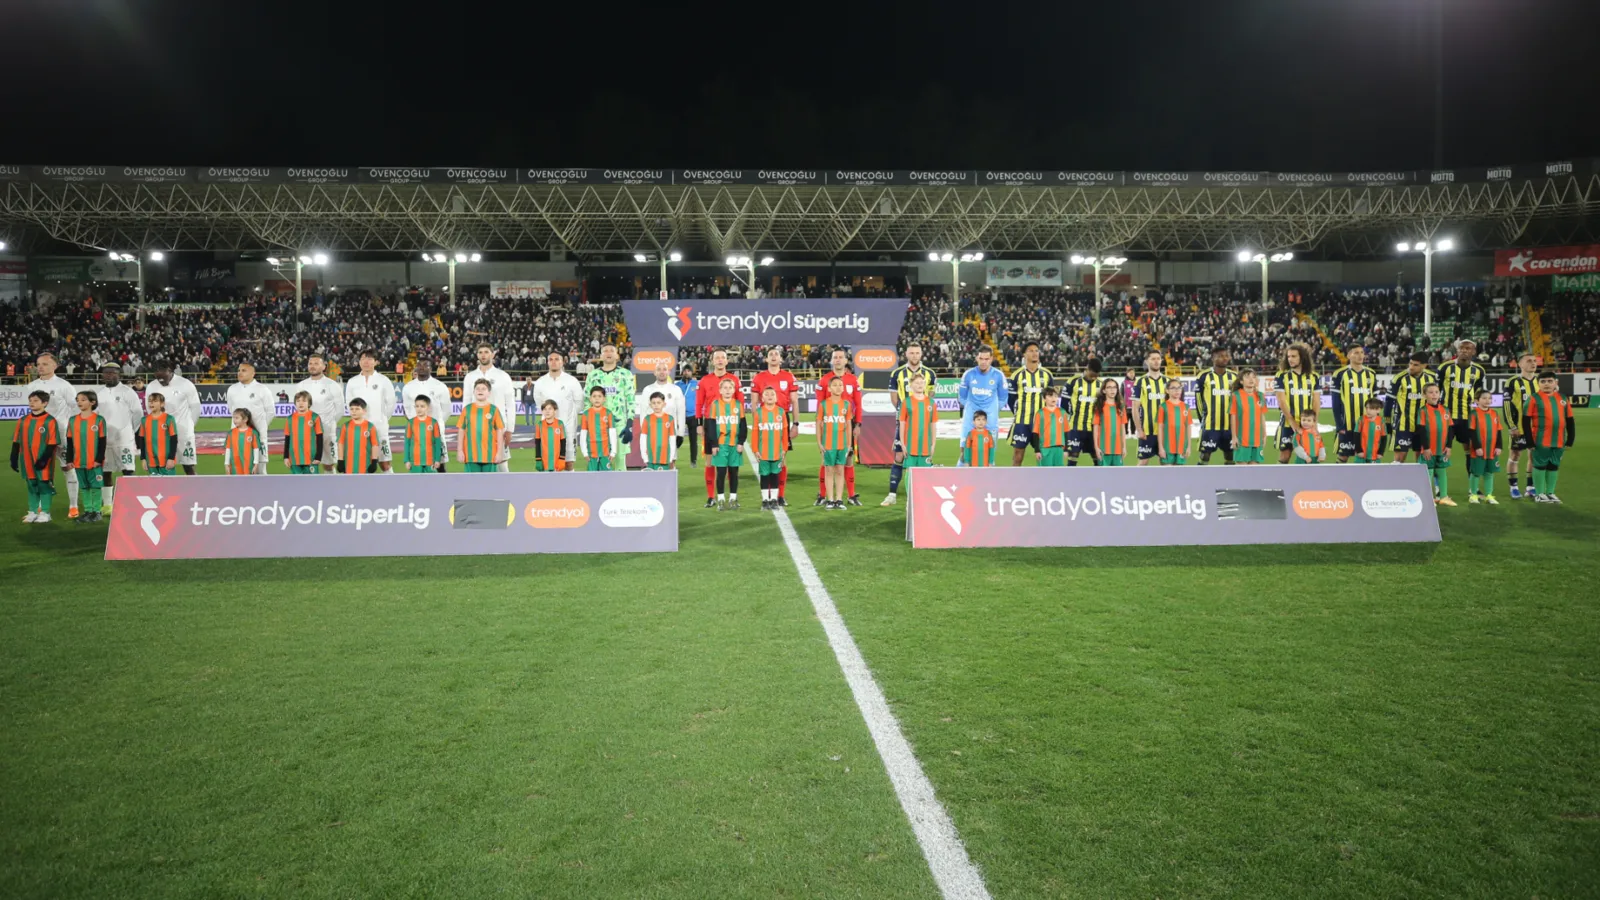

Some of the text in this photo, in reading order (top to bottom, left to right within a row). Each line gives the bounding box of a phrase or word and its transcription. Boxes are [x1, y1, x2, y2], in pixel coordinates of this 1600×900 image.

[208, 167, 270, 178] ÖVENÇOĞLU
[287, 167, 348, 178] ÖVENÇOĞLU
[369, 168, 430, 178] ÖVENÇOĞLU
[446, 168, 507, 179] ÖVENÇOĞLU
[527, 169, 588, 179] ÖVENÇOĞLU
[603, 169, 663, 179] ÖVENÇOĞLU
[683, 170, 742, 180] ÖVENÇOĞLU
[757, 170, 816, 180] ÖVENÇOĞLU
[836, 171, 894, 181] ÖVENÇOĞLU
[909, 171, 966, 181] ÖVENÇOĞLU
[986, 172, 1043, 182] ÖVENÇOĞLU
[1058, 172, 1114, 182] ÖVENÇOĞLU
[1133, 172, 1189, 182] ÖVENÇOĞLU
[1529, 255, 1598, 269] corendon
[696, 311, 791, 334] trendyol
[637, 354, 672, 366] trendyol
[858, 353, 893, 366] trendyol
[758, 422, 783, 432] SAYGI
[183, 448, 194, 457] 42
[380, 446, 390, 455] 16
[984, 491, 1107, 520] trendyol
[1298, 498, 1349, 512] trendyol
[190, 500, 323, 530] trendyol
[531, 507, 584, 521] trendyol
